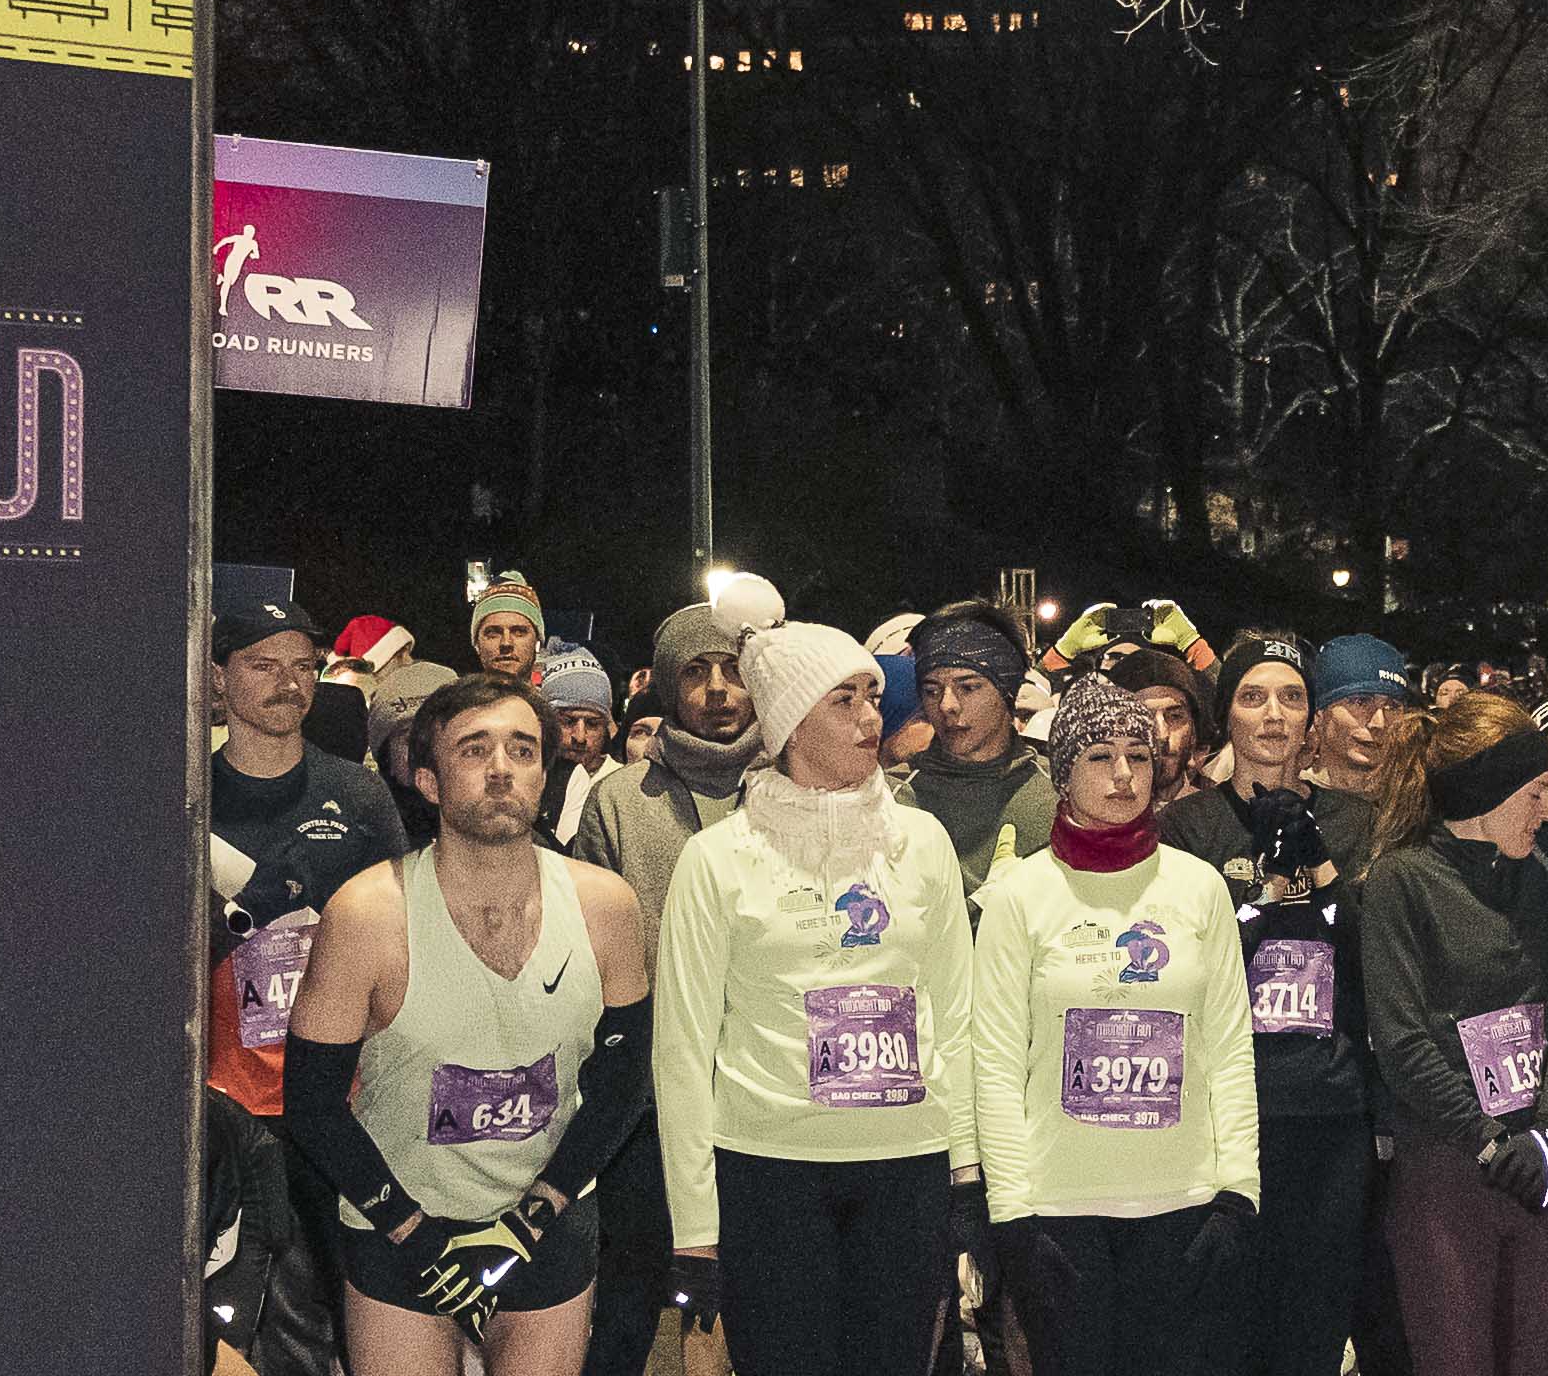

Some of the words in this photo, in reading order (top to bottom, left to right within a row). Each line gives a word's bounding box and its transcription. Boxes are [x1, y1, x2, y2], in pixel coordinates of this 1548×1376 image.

[212, 332, 260, 352] OAD
[267, 337, 374, 362] RUNNERS
[795, 917, 828, 931] HERE'S
[1075, 953, 1107, 965] HERE'S
[1110, 952, 1122, 961] TO
[242, 980, 264, 1010] A
[1252, 982, 1318, 1020] 3714
[838, 1030, 909, 1073] 3980
[1091, 1055, 1169, 1094] 3979
[831, 1091, 851, 1101] BAG
[851, 1091, 882, 1101] CHECK
[884, 1088, 909, 1103] 3980
[434, 1108, 458, 1129] A
[472, 1093, 535, 1131] 634
[1080, 1113, 1100, 1122] BAG
[1099, 1113, 1131, 1122] CHECK
[1134, 1111, 1160, 1126] 3979
